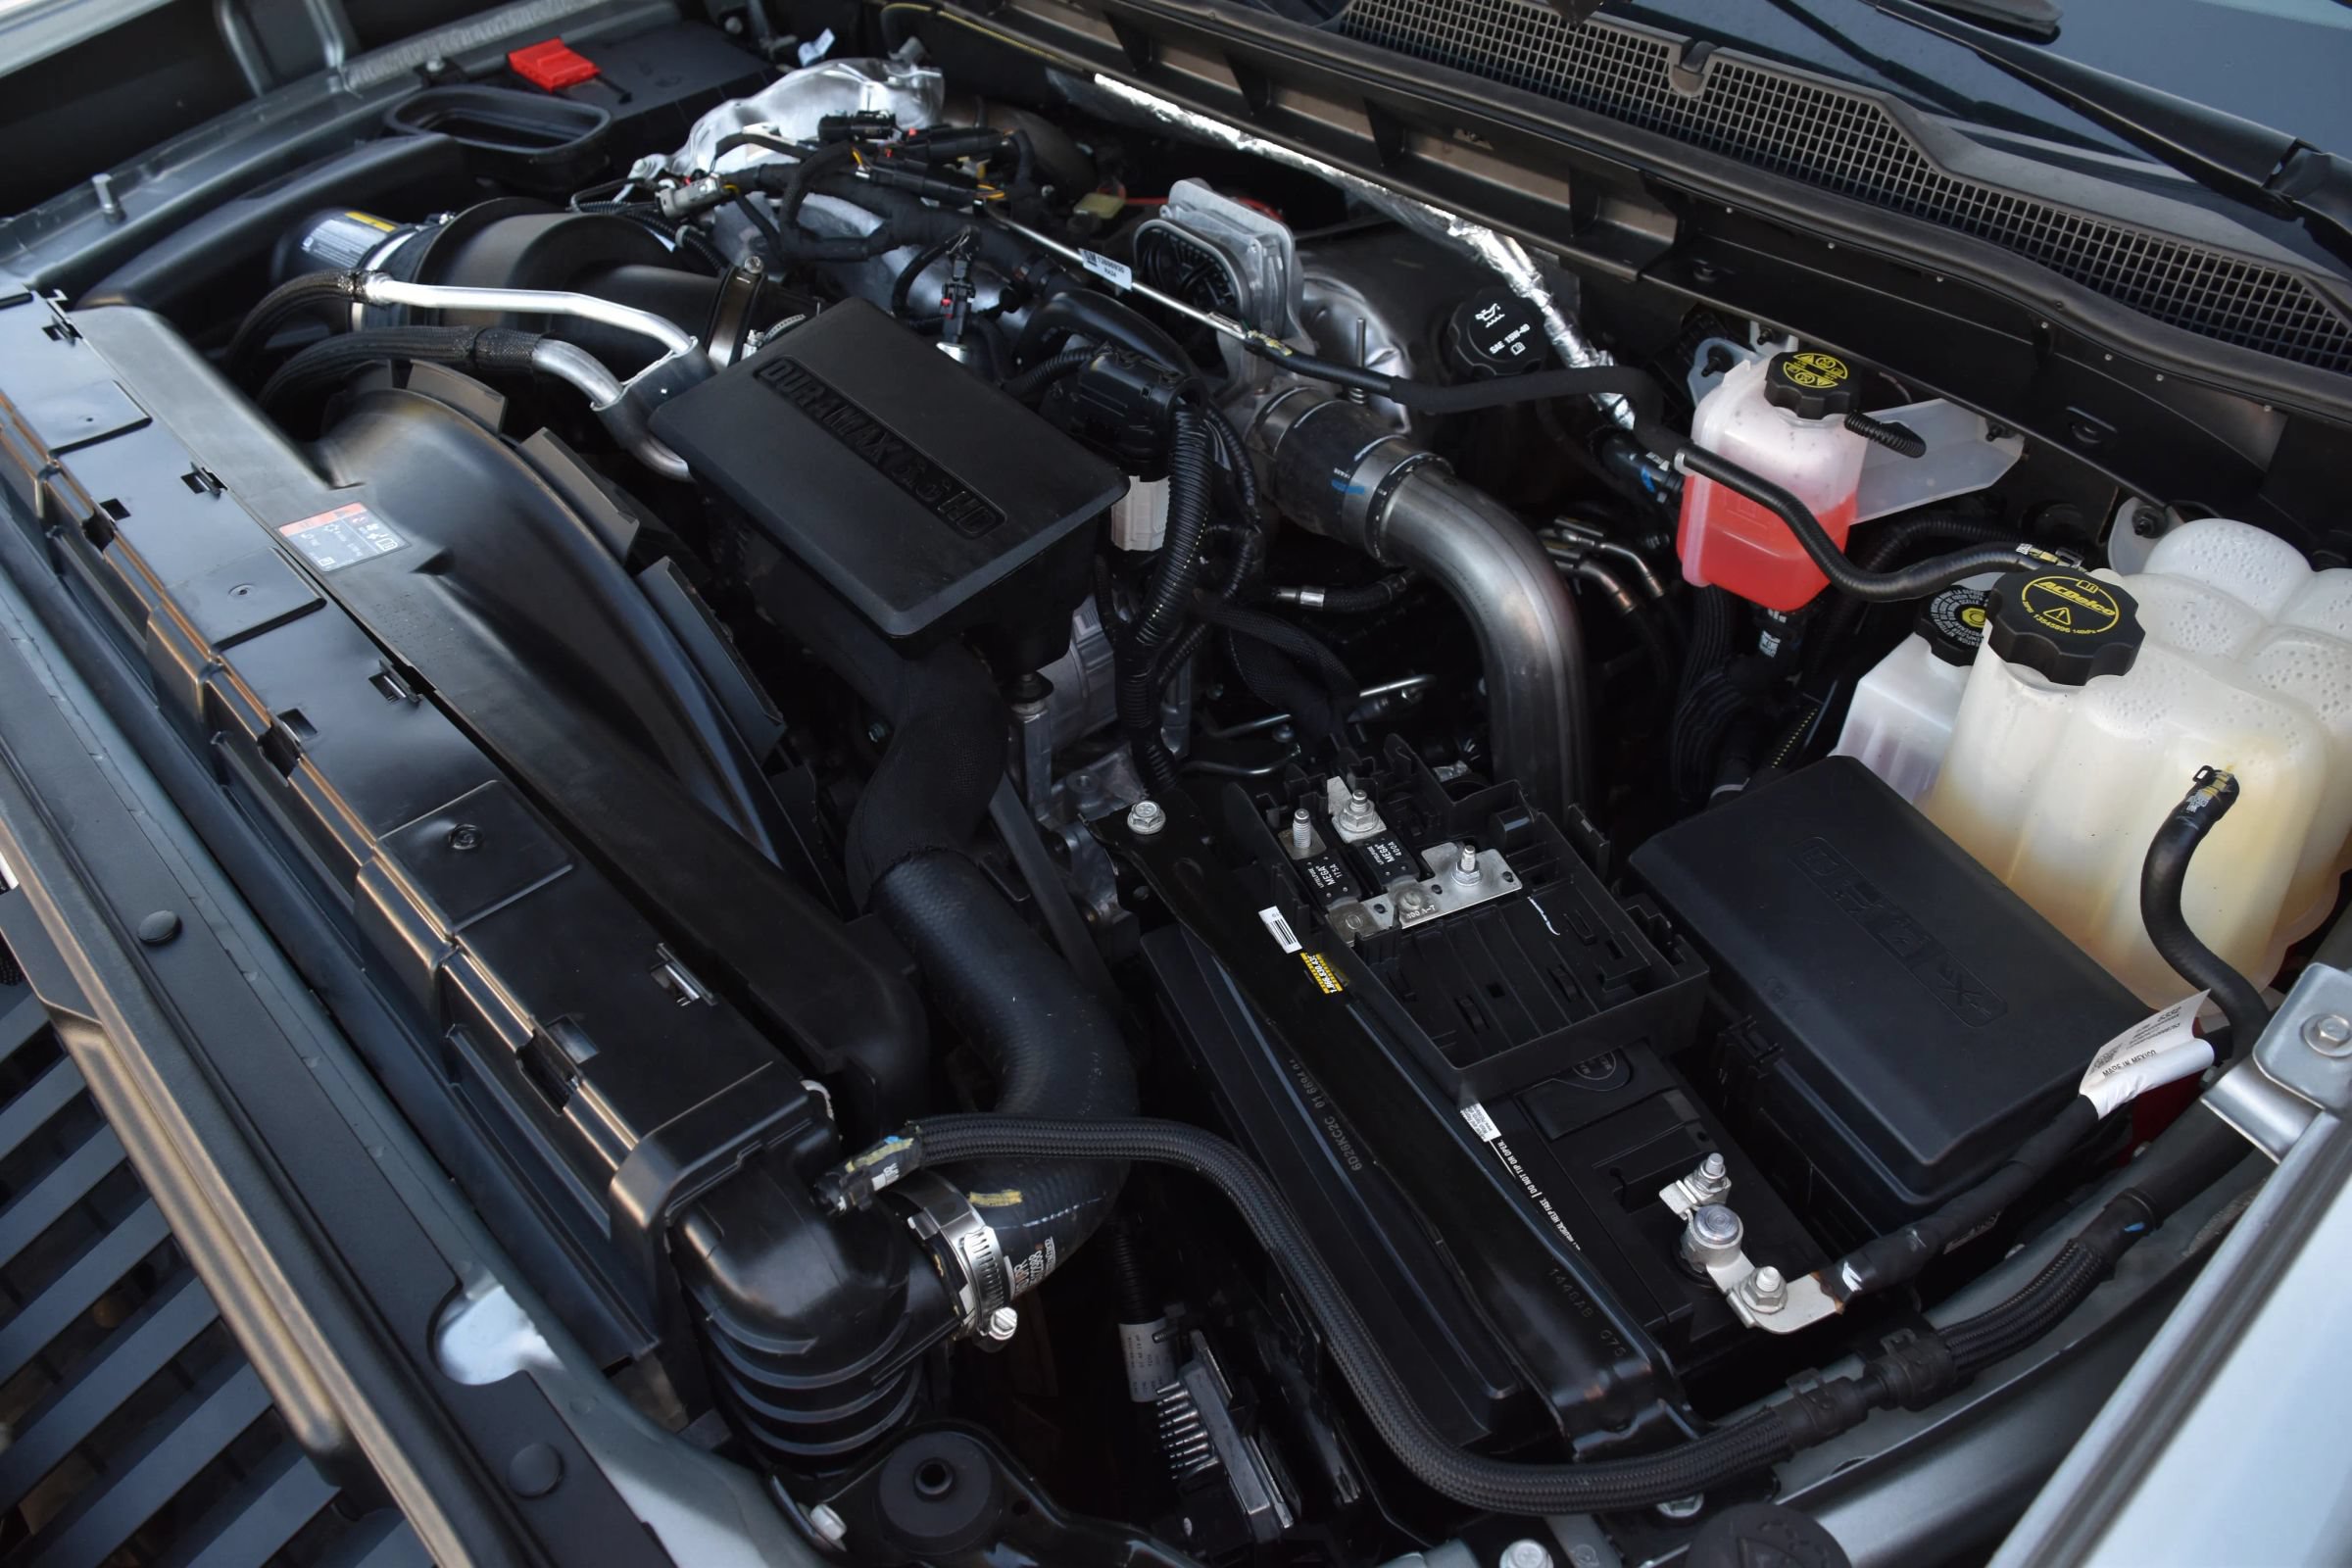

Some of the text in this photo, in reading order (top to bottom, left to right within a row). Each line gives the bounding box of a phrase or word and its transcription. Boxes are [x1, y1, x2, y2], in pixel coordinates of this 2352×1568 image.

[1490, 323, 1531, 354] SAE 15W-40
[760, 358, 903, 466] DURAMAX
[937, 489, 998, 535] HD
[2036, 581, 2116, 616] ACDelco
[1388, 841, 1401, 857] 400A
[1329, 863, 1343, 878] 175A
[2102, 1049, 2157, 1077] MADE IN MEXICO
[1497, 1140, 1512, 1156] OPEN.
[1507, 1153, 1517, 1165] OR
[1513, 1162, 1524, 1175] TIP
[1519, 1173, 1532, 1186] NOT
[1527, 1184, 1538, 1195] DO
[1540, 1197, 1552, 1211] FAST.
[1547, 1210, 1560, 1224] HELP
